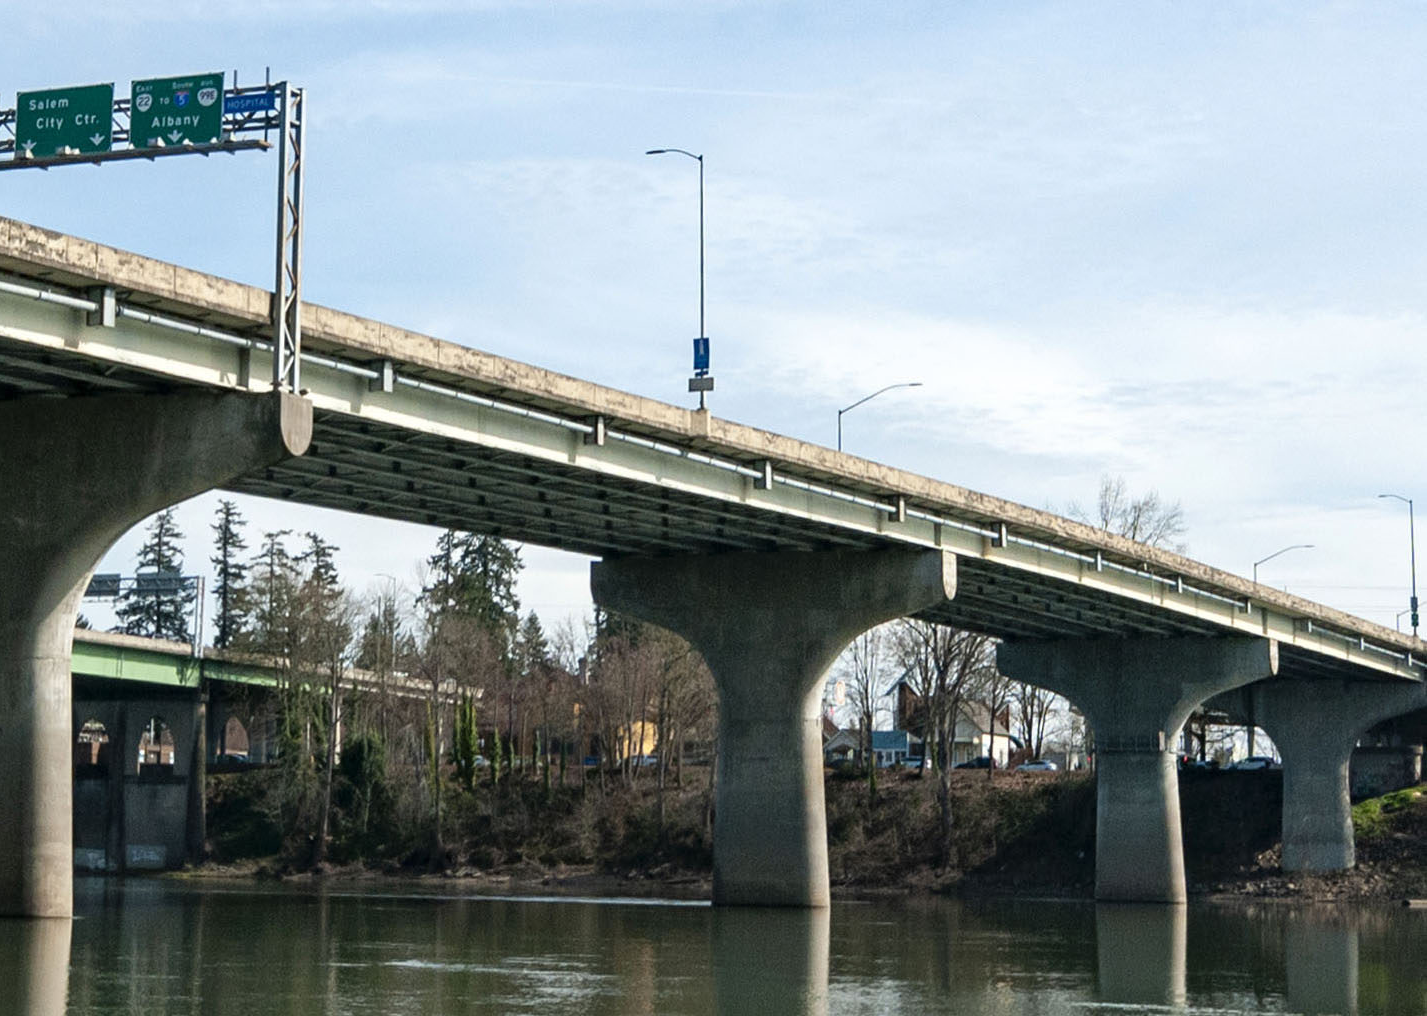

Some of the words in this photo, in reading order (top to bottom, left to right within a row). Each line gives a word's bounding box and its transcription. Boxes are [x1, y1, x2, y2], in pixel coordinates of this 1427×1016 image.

[199, 88, 216, 100] 99E
[29, 98, 69, 111] Salem
[137, 96, 151, 107] 22
[178, 95, 185, 106] 5
[227, 97, 269, 109] HOSPITAL
[36, 117, 63, 130] City
[75, 114, 99, 125] Ctr.
[151, 115, 200, 128] Albany
